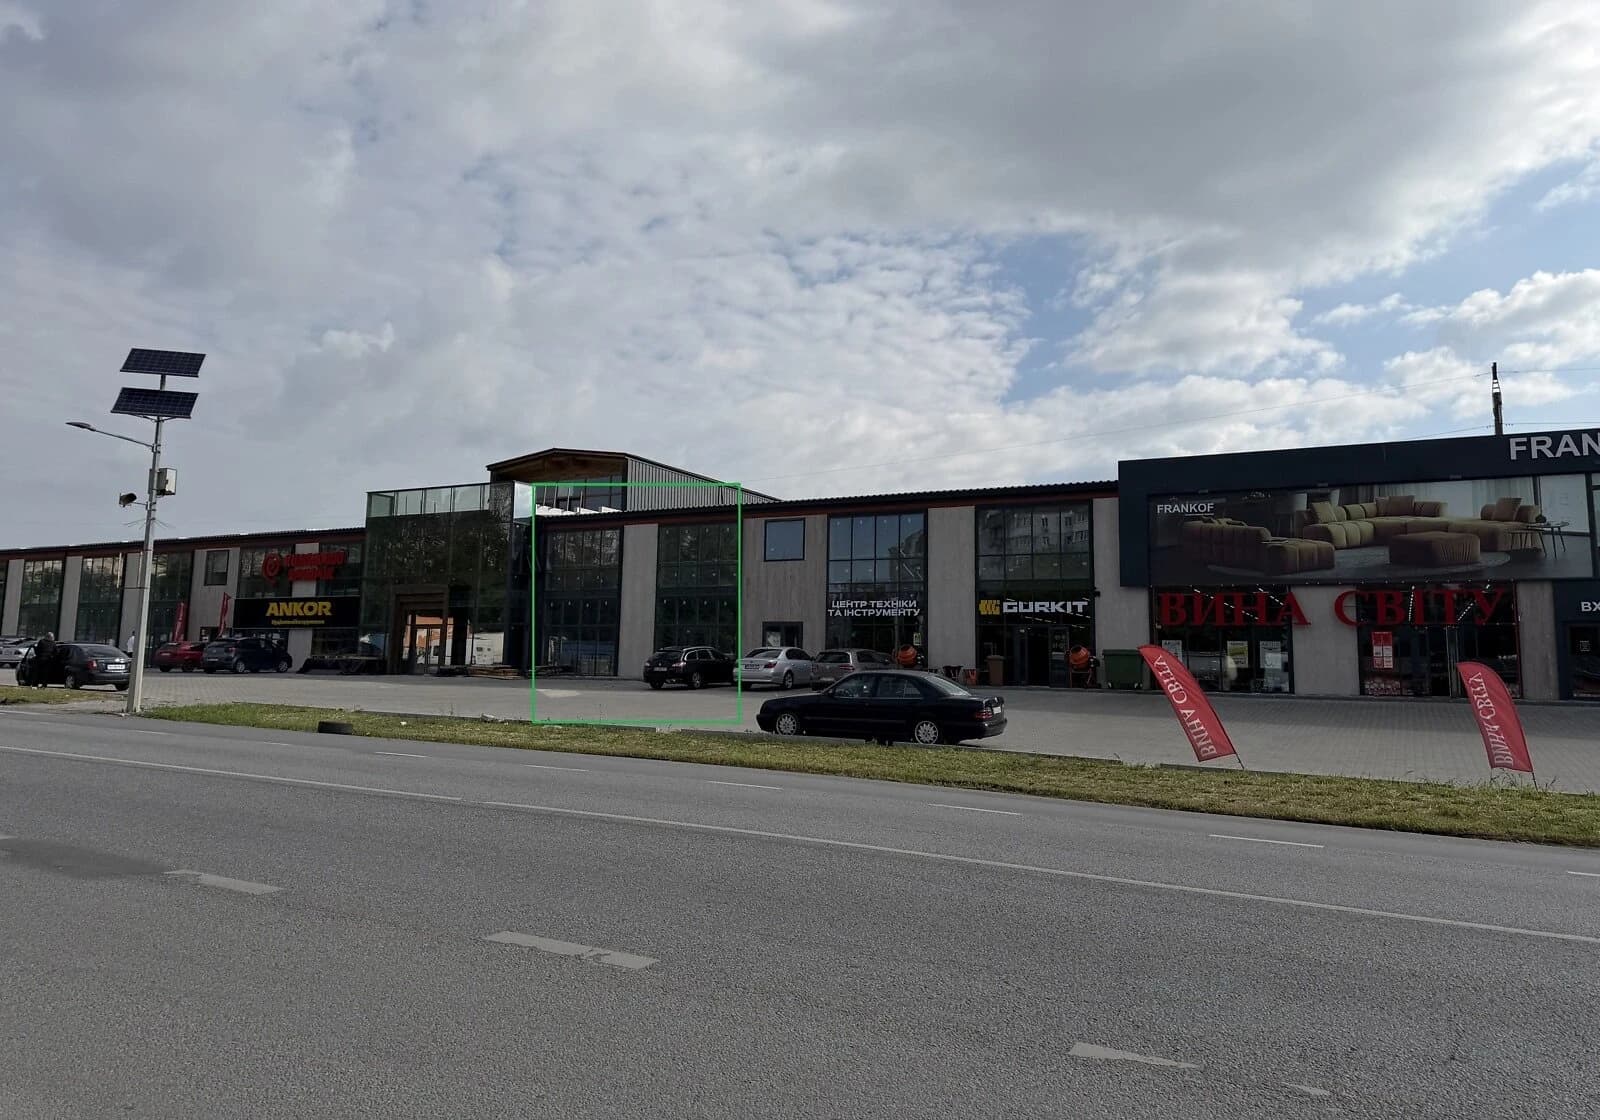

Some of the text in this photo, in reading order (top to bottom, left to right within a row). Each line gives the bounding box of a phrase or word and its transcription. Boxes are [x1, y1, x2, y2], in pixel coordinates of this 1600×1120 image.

[1157, 502, 1214, 514] FRANKOF
[265, 601, 332, 617] ANKOR
[831, 599, 917, 609] ЦЕНТР ТЕХНІКИ
[1002, 601, 1089, 613] GURKIT
[1158, 588, 1505, 628] ВИНА СВІТУ
[827, 608, 921, 617] ТА ІНСТРУМЕНТУ
